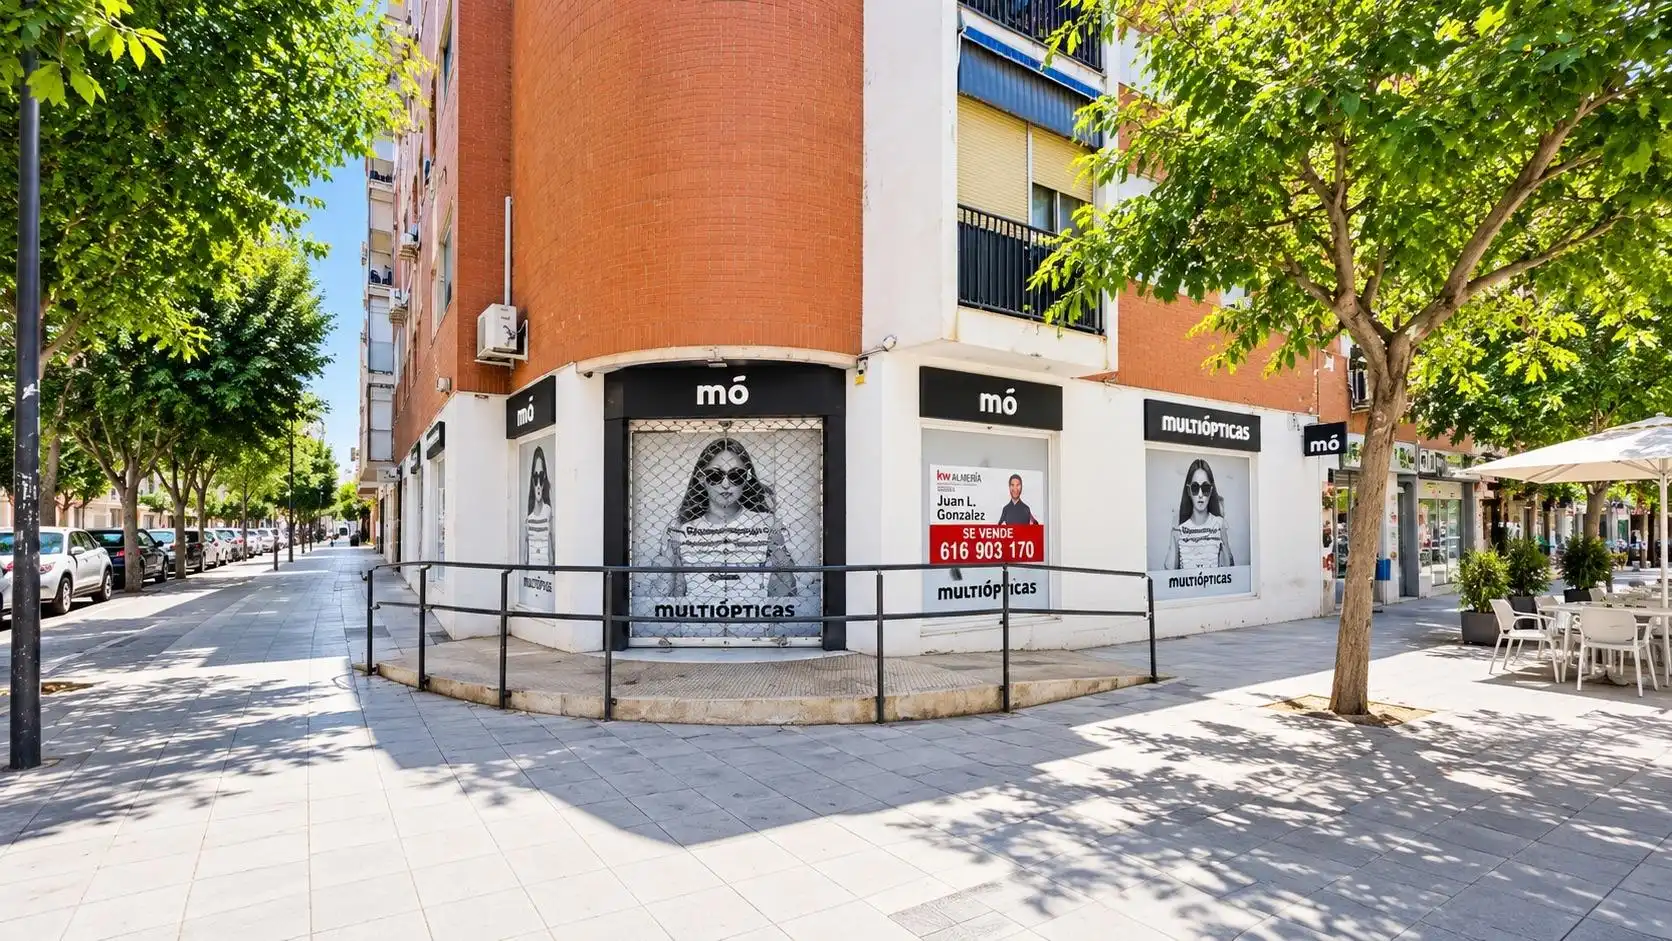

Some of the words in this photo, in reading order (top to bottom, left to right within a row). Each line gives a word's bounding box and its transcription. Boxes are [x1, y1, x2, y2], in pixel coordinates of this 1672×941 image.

[697, 375, 750, 405] mó
[516, 395, 535, 427] mó
[979, 387, 1018, 416] mó
[1310, 434, 1340, 453] mó
[951, 471, 982, 483] ALMERÍA
[937, 494, 965, 507] Juan
[966, 495, 976, 507] L.
[962, 527, 977, 540] SE
[978, 527, 1014, 540] VENDE
[940, 541, 969, 561] 616
[975, 541, 1003, 560] 903
[1009, 540, 1035, 559] 170
